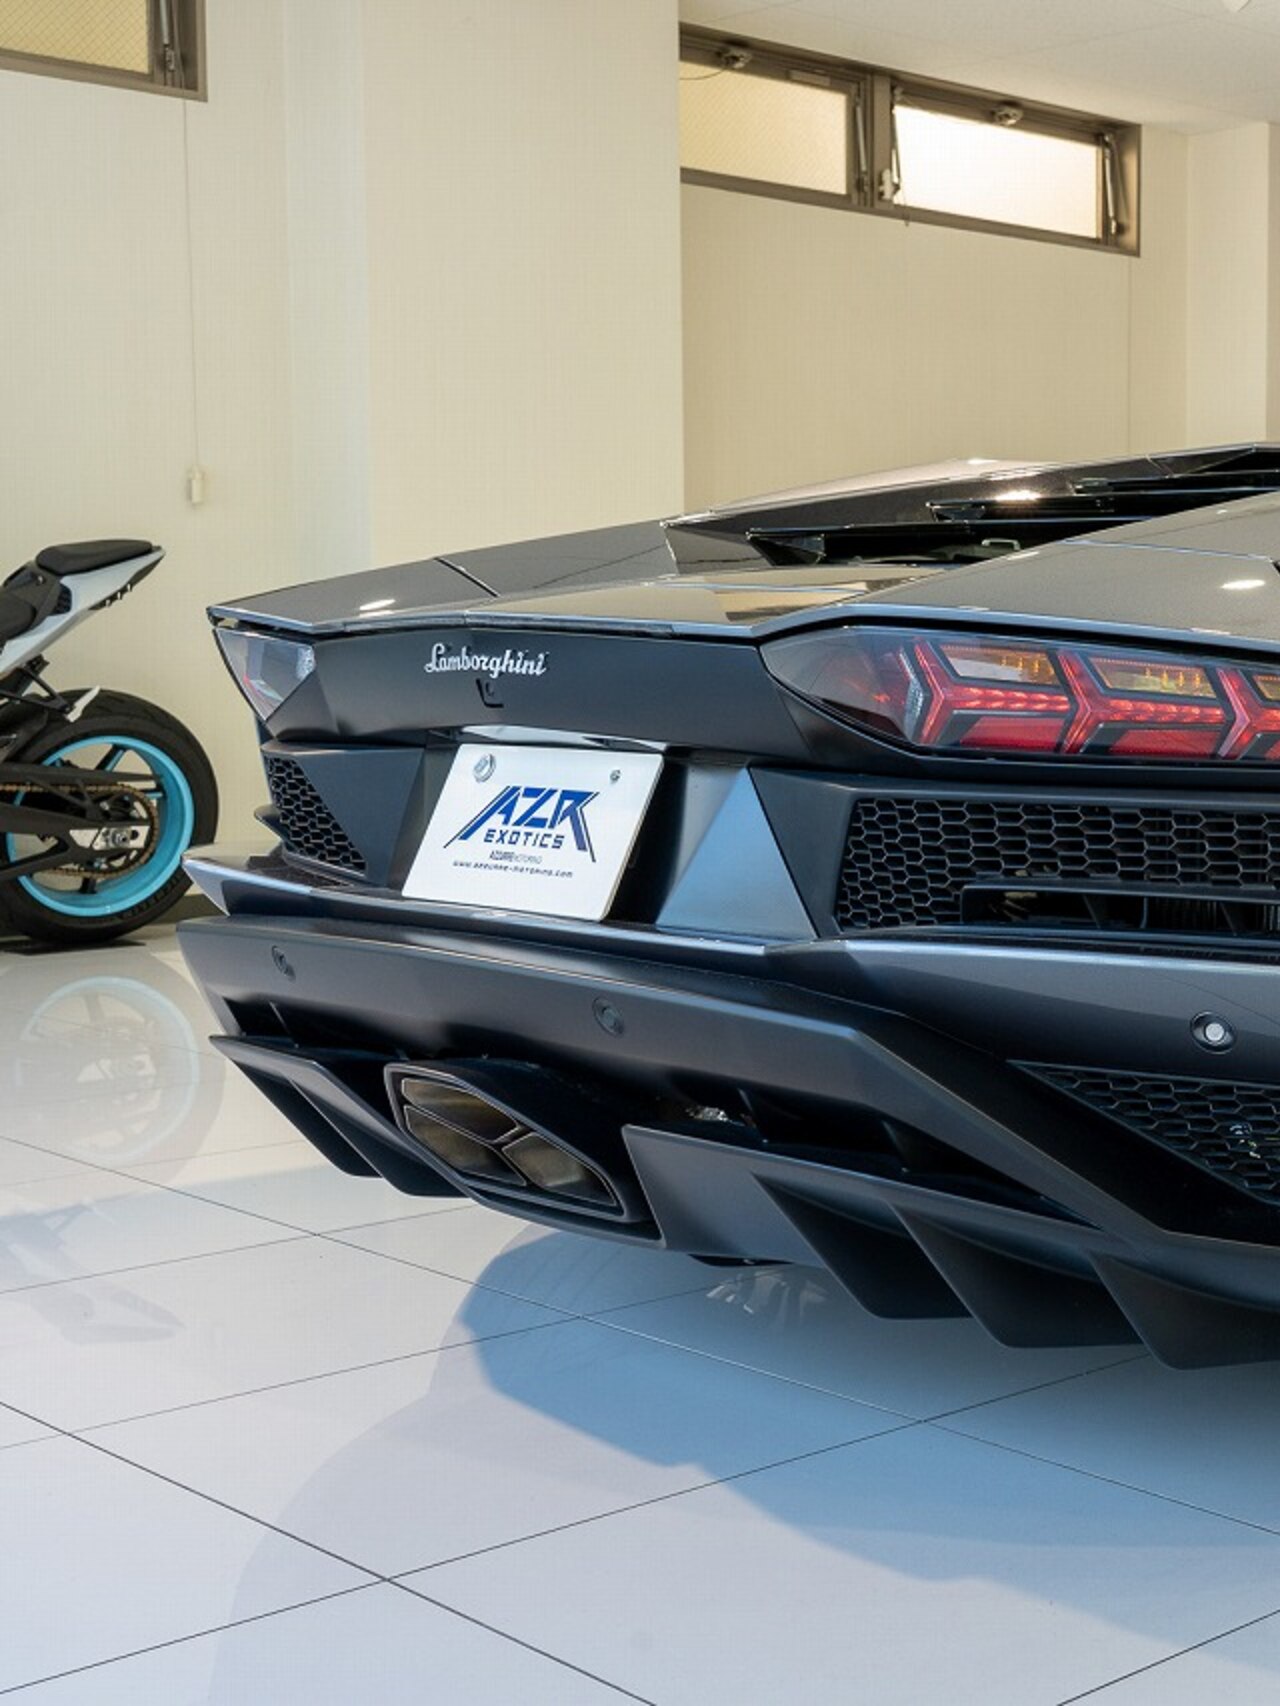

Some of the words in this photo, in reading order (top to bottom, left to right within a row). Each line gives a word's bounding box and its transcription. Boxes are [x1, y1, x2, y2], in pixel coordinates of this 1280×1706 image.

[424, 643, 549, 679] Lamborghini
[446, 785, 598, 859] AZR
[483, 828, 565, 850] EXOTICS
